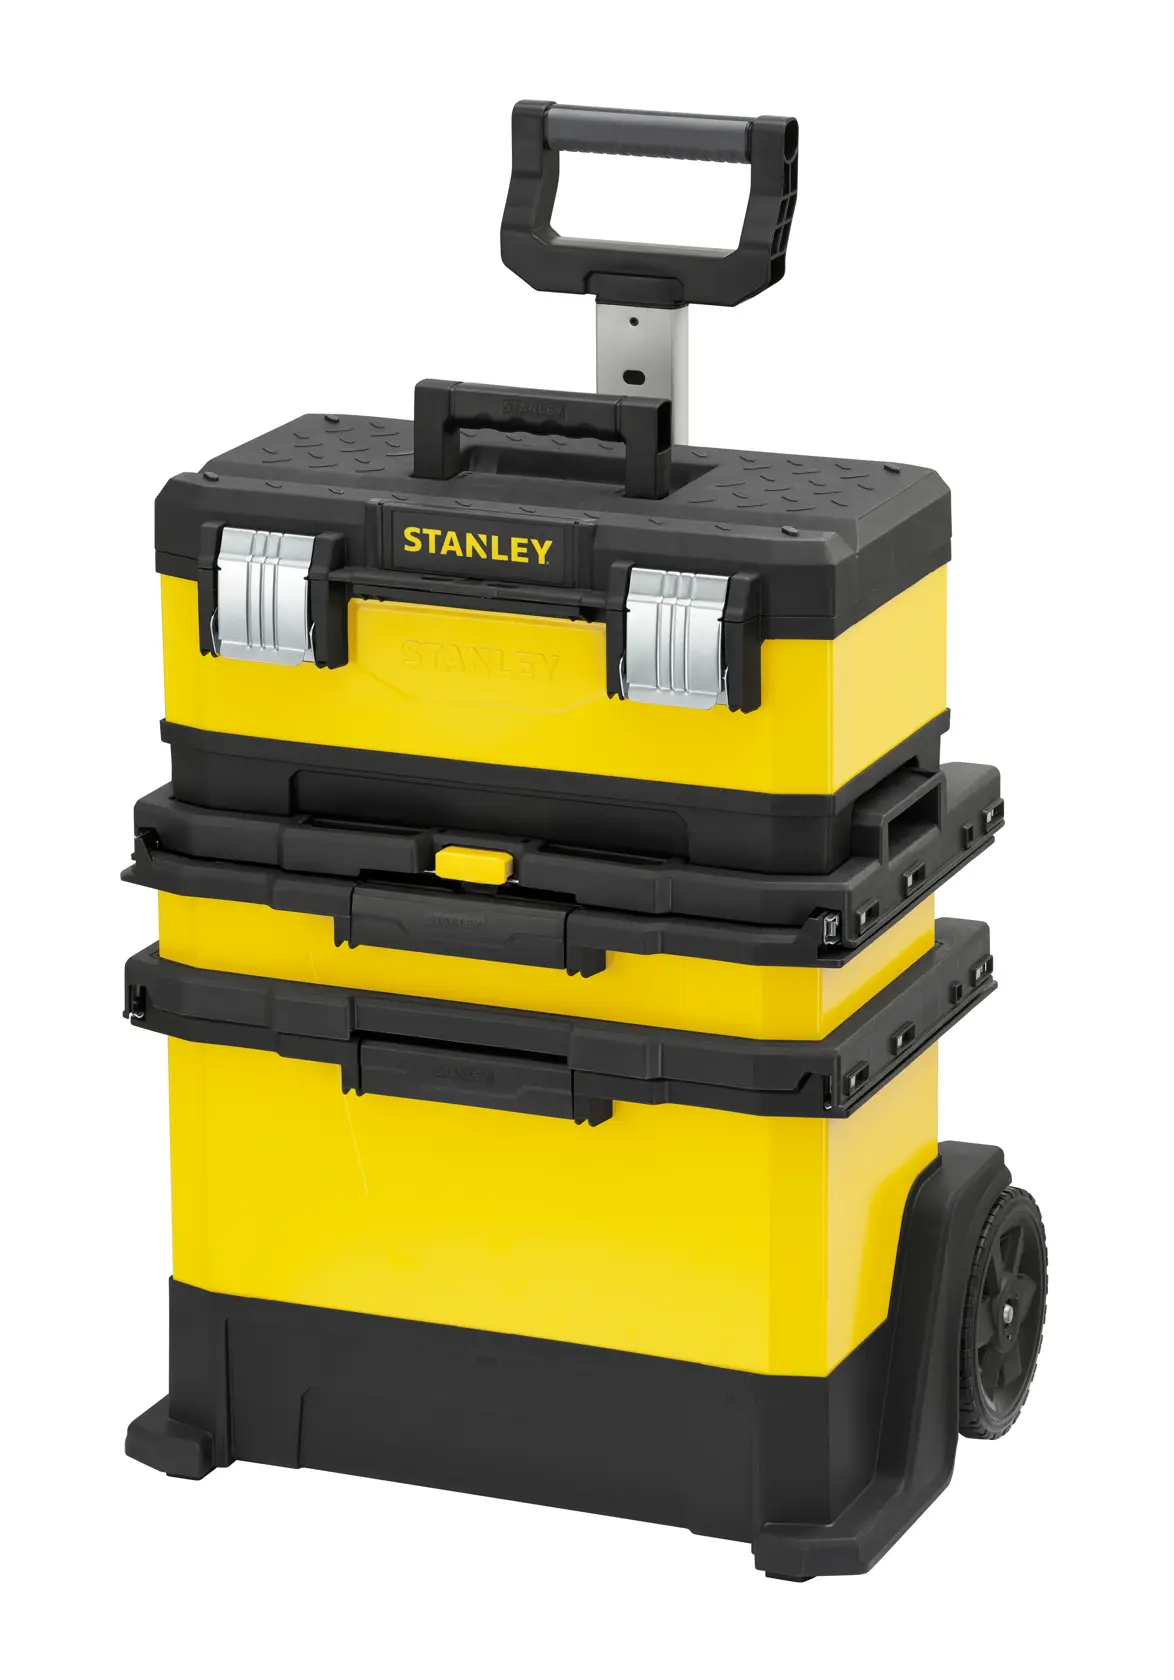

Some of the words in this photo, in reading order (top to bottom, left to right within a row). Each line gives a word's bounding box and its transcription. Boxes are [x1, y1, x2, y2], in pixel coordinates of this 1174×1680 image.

[503, 400, 563, 417] STANLEY
[404, 526, 553, 565] STANLEY
[402, 639, 560, 683] STANLEY
